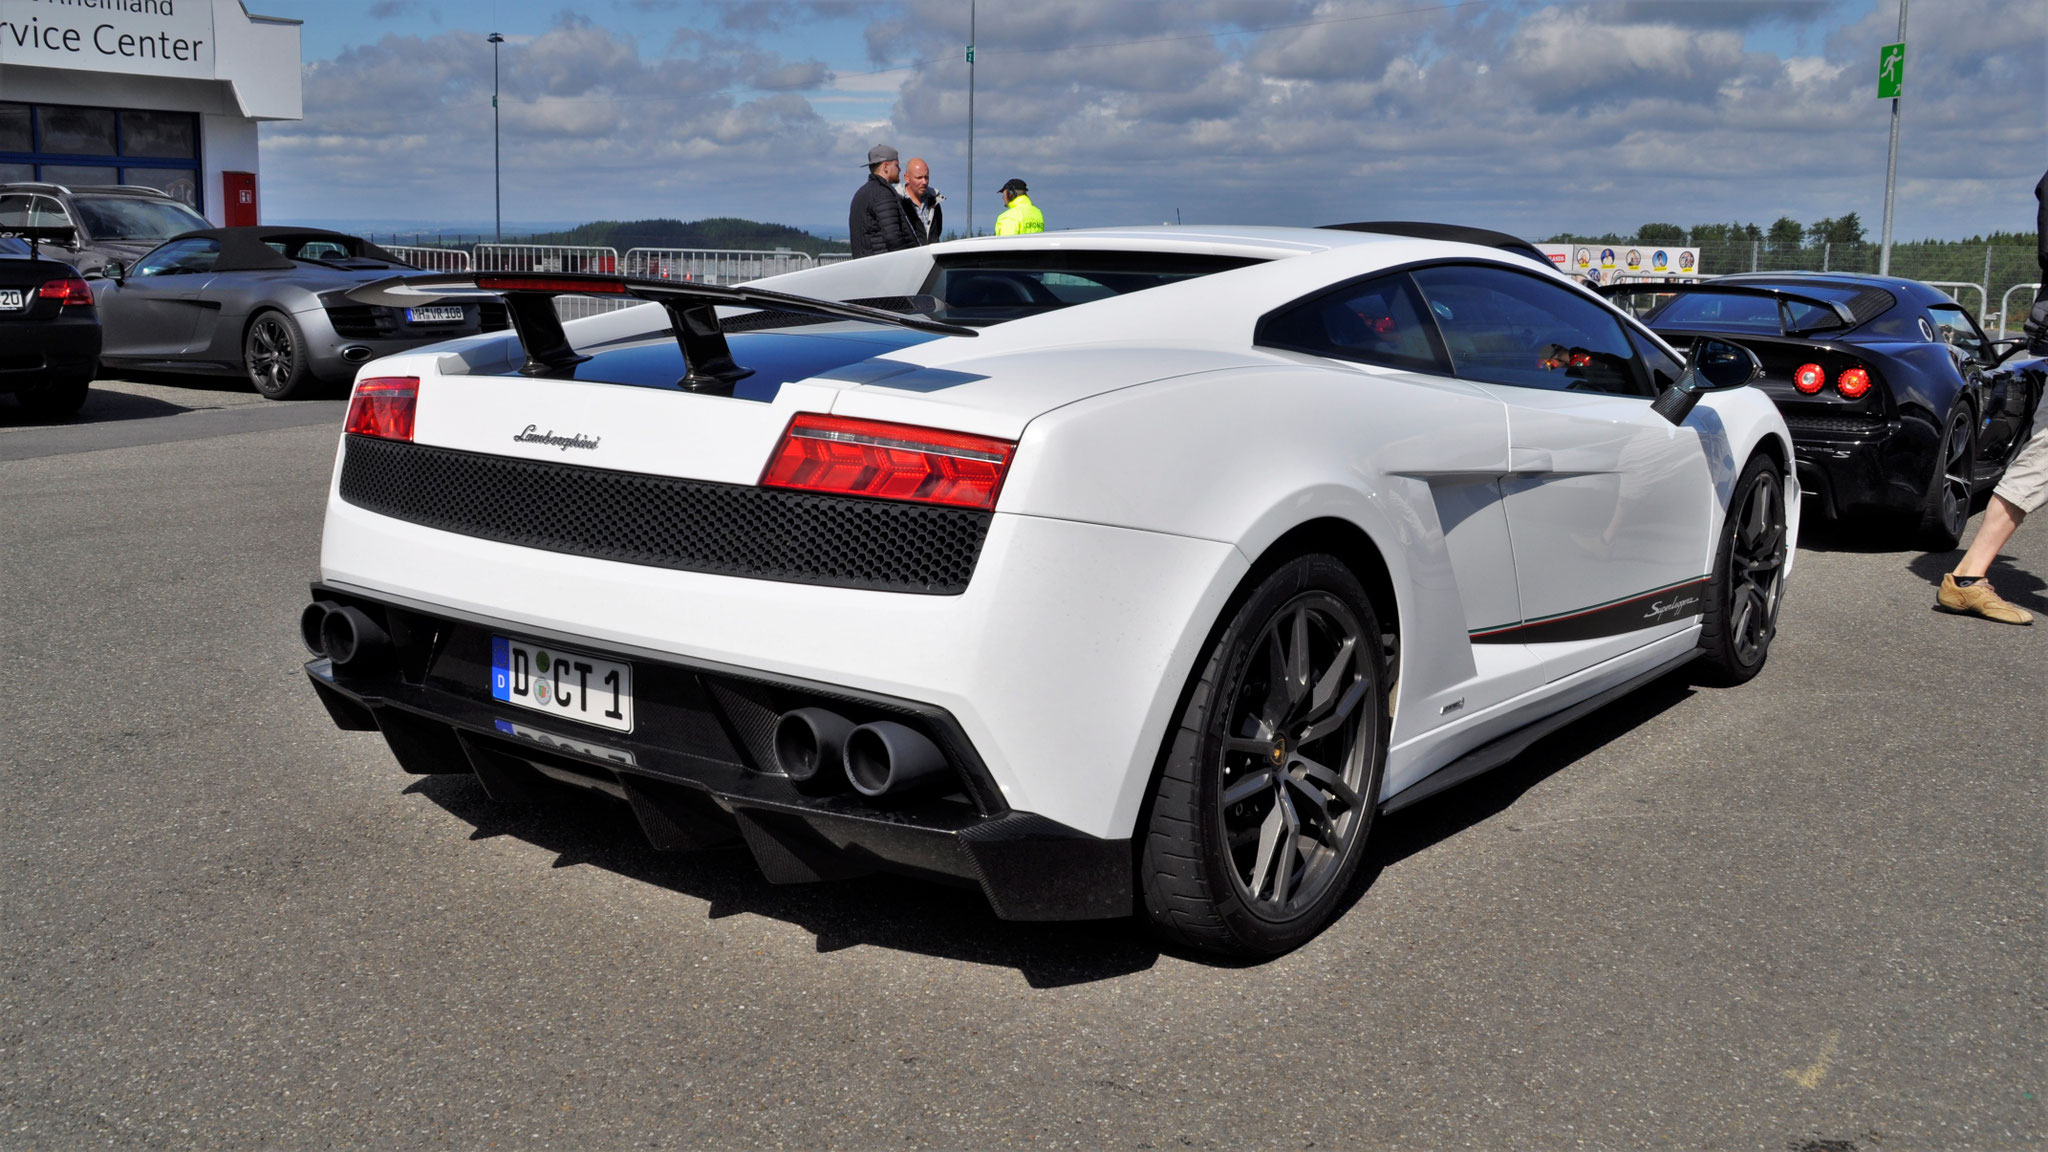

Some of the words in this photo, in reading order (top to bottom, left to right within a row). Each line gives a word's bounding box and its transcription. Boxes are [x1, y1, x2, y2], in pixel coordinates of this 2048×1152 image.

[93, 24, 203, 61] Center
[1, 291, 19, 305] 20
[445, 307, 461, 319] 108
[513, 424, 601, 451] Lamborghini
[498, 674, 505, 688] D
[513, 648, 528, 696] D
[554, 658, 592, 712] CT
[605, 670, 623, 720] 1
